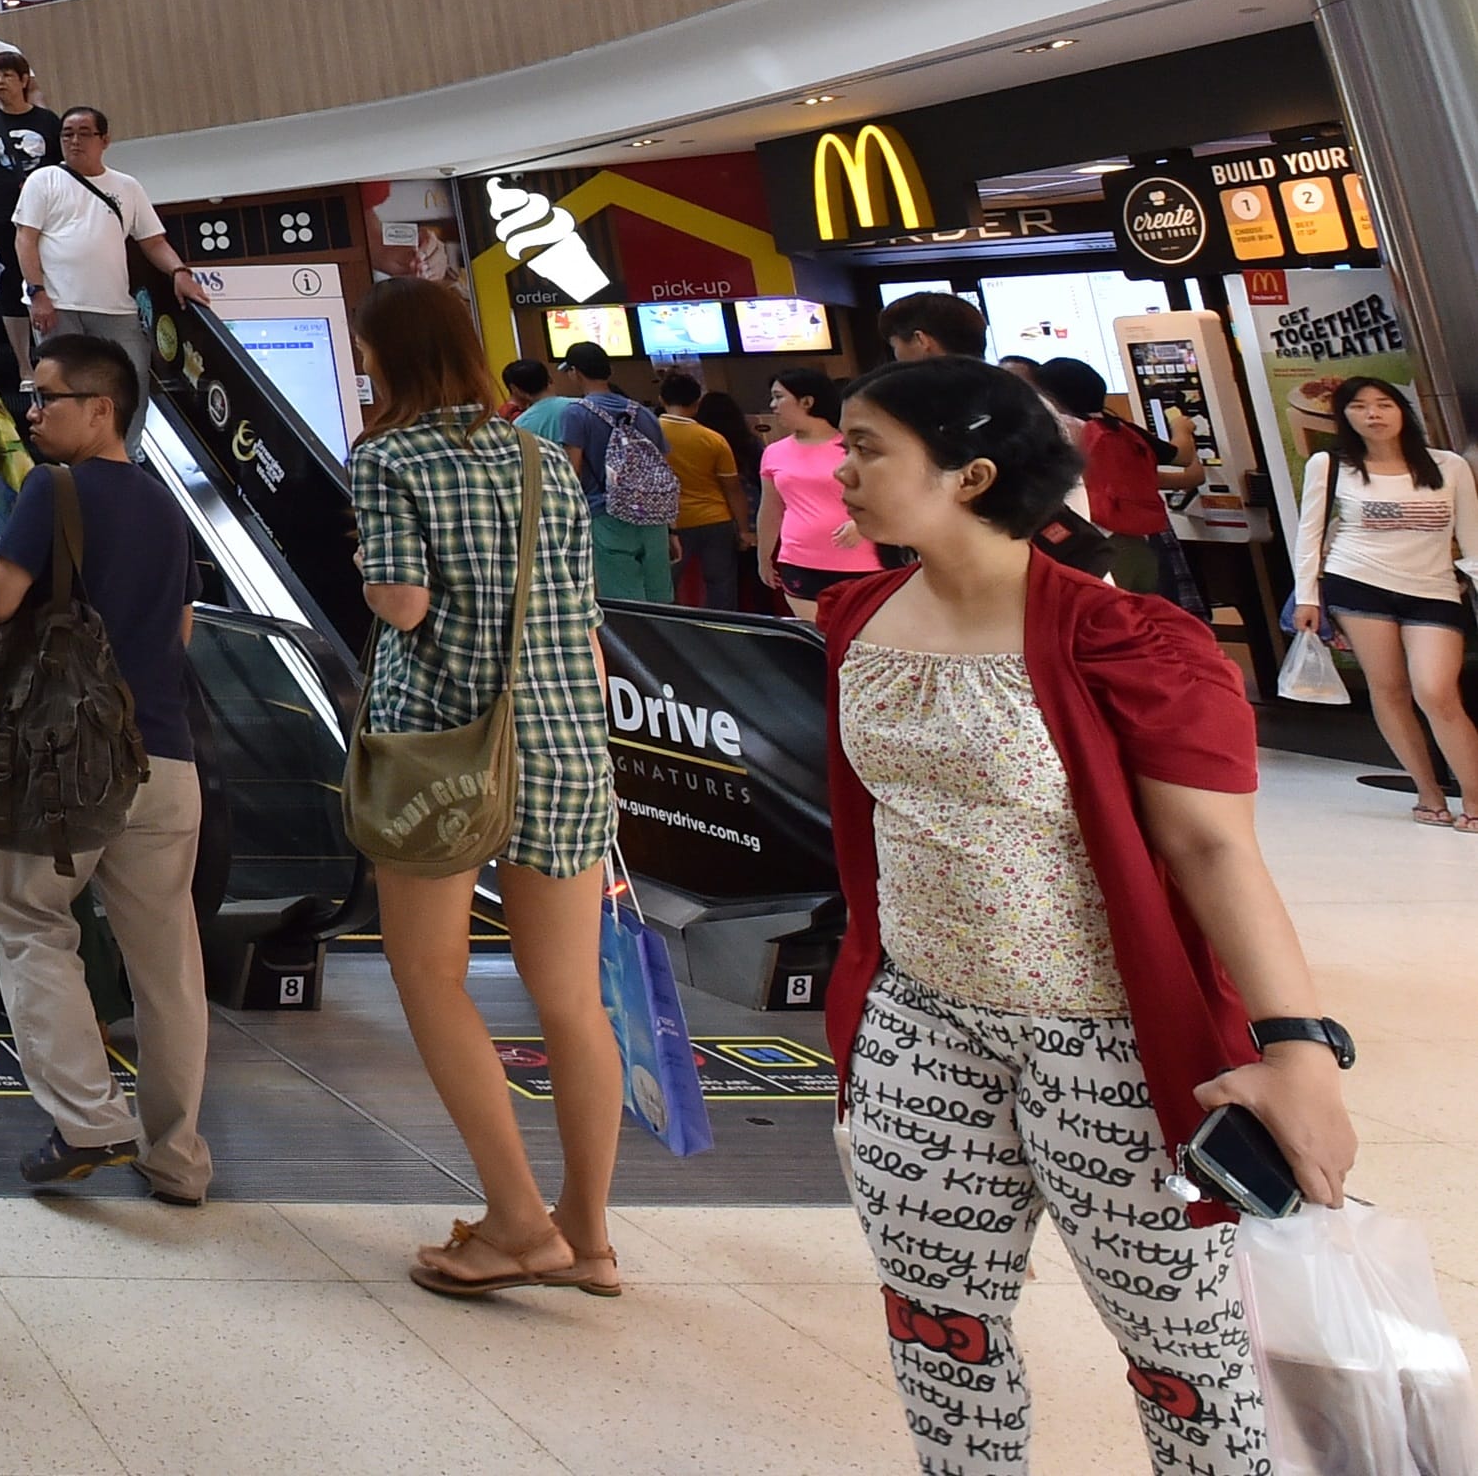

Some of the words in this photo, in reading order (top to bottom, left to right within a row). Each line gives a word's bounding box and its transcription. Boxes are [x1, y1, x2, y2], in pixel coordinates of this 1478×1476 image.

[1211, 157, 1277, 185] BUILD
[1282, 146, 1350, 176] YOUR
[1133, 203, 1196, 233] create
[1241, 198, 1252, 212] 1
[1302, 190, 1315, 205] 2
[1137, 231, 1164, 242] YOUR
[1167, 226, 1199, 239] TASTE
[515, 289, 559, 306] order
[651, 278, 732, 300] pick-up
[1270, 293, 1392, 348] TOGETHER
[1277, 306, 1310, 328] GET
[1275, 347, 1301, 359] FOR
[1301, 345, 1310, 357] A
[608, 675, 743, 757] Drive
[380, 791, 431, 849] BODY
[430, 770, 497, 806] GLOVE
[284, 978, 299, 998] 8
[792, 976, 807, 998] 8
[912, 1053, 1008, 1105] Kitty
[876, 1082, 996, 1129] Hello
[862, 1103, 957, 1161] Kitty
[1057, 1108, 1157, 1163] Kitty
[1030, 1131, 1136, 1187] Hello
[943, 1167, 1036, 1211] Kitty
[897, 1194, 1017, 1233] Hello
[880, 1224, 977, 1277] Kitty
[1092, 1227, 1199, 1280] Kitty
[900, 1344, 996, 1393] Hello
